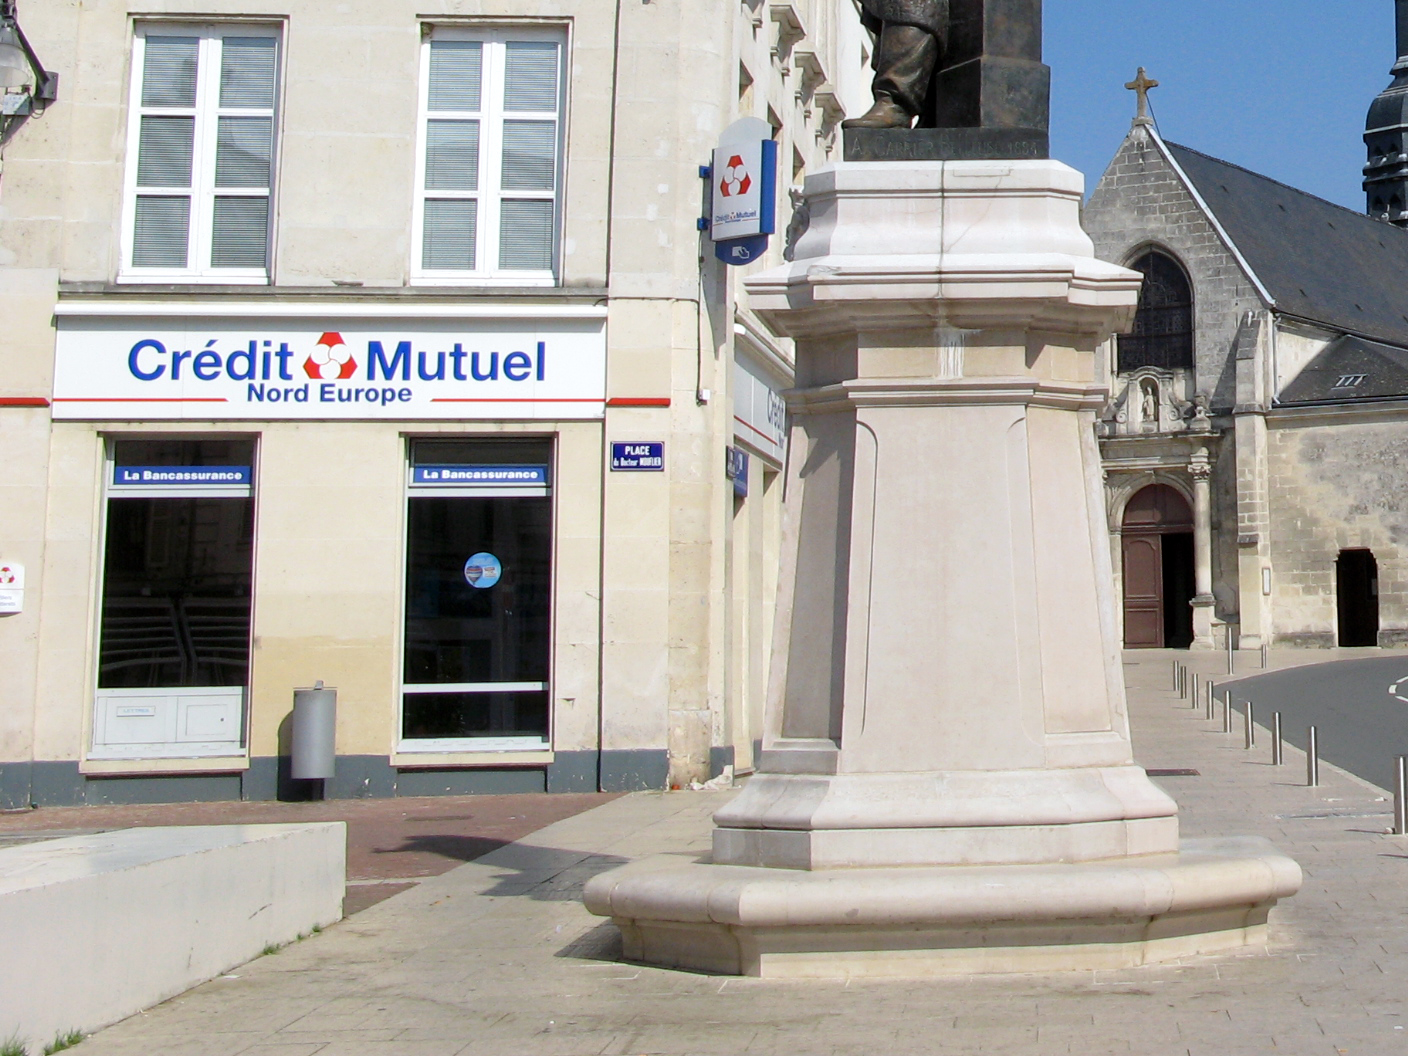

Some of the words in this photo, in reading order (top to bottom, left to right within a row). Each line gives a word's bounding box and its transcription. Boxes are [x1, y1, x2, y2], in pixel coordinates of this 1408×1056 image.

[128, 339, 294, 382] Crédit
[367, 341, 546, 382] Mutuel
[247, 383, 309, 403] Nord
[319, 384, 413, 407] Europe
[625, 445, 651, 456] PLACE
[124, 470, 140, 481] La
[143, 470, 243, 481] Bancassurance
[423, 469, 439, 479] La
[442, 469, 538, 479] Bancassurance
